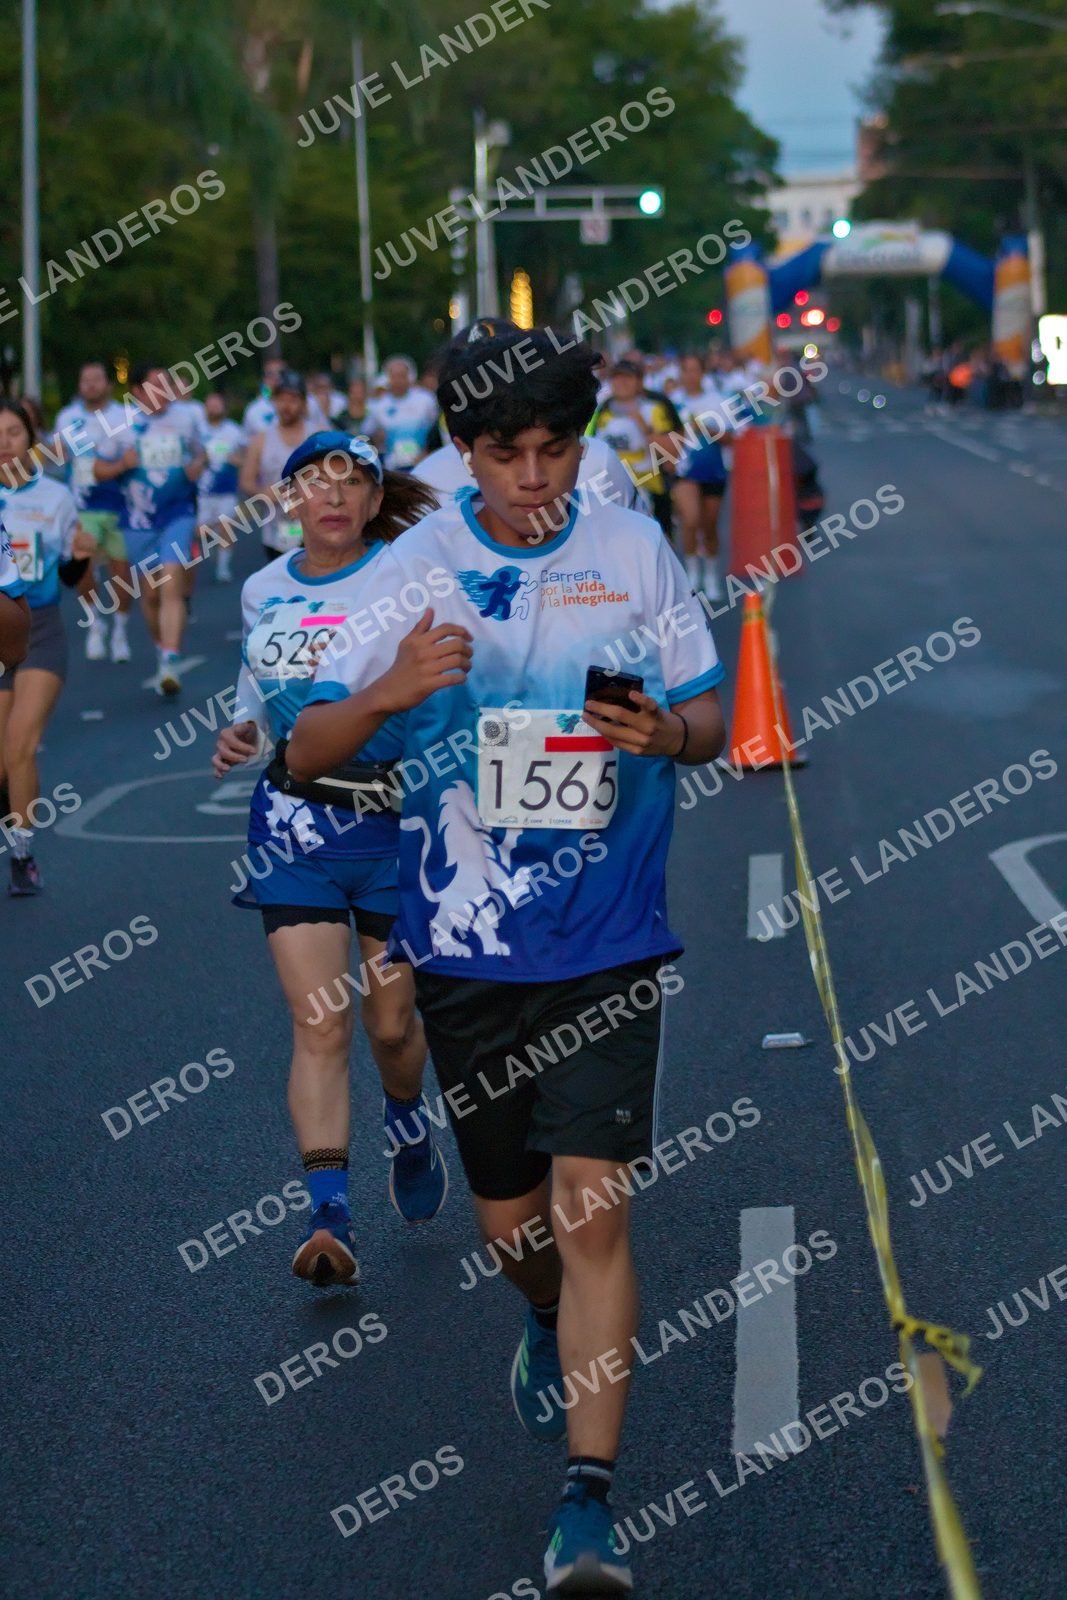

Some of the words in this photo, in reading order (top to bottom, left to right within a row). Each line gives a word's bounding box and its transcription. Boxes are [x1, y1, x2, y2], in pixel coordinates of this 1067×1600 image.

[540, 569, 601, 583] Carrera
[540, 585, 557, 597] por
[562, 583, 572, 594] la
[575, 580, 606, 593] Vida
[549, 597, 560, 608] la
[563, 591, 629, 607] Integridad
[489, 759, 617, 811] 1565
